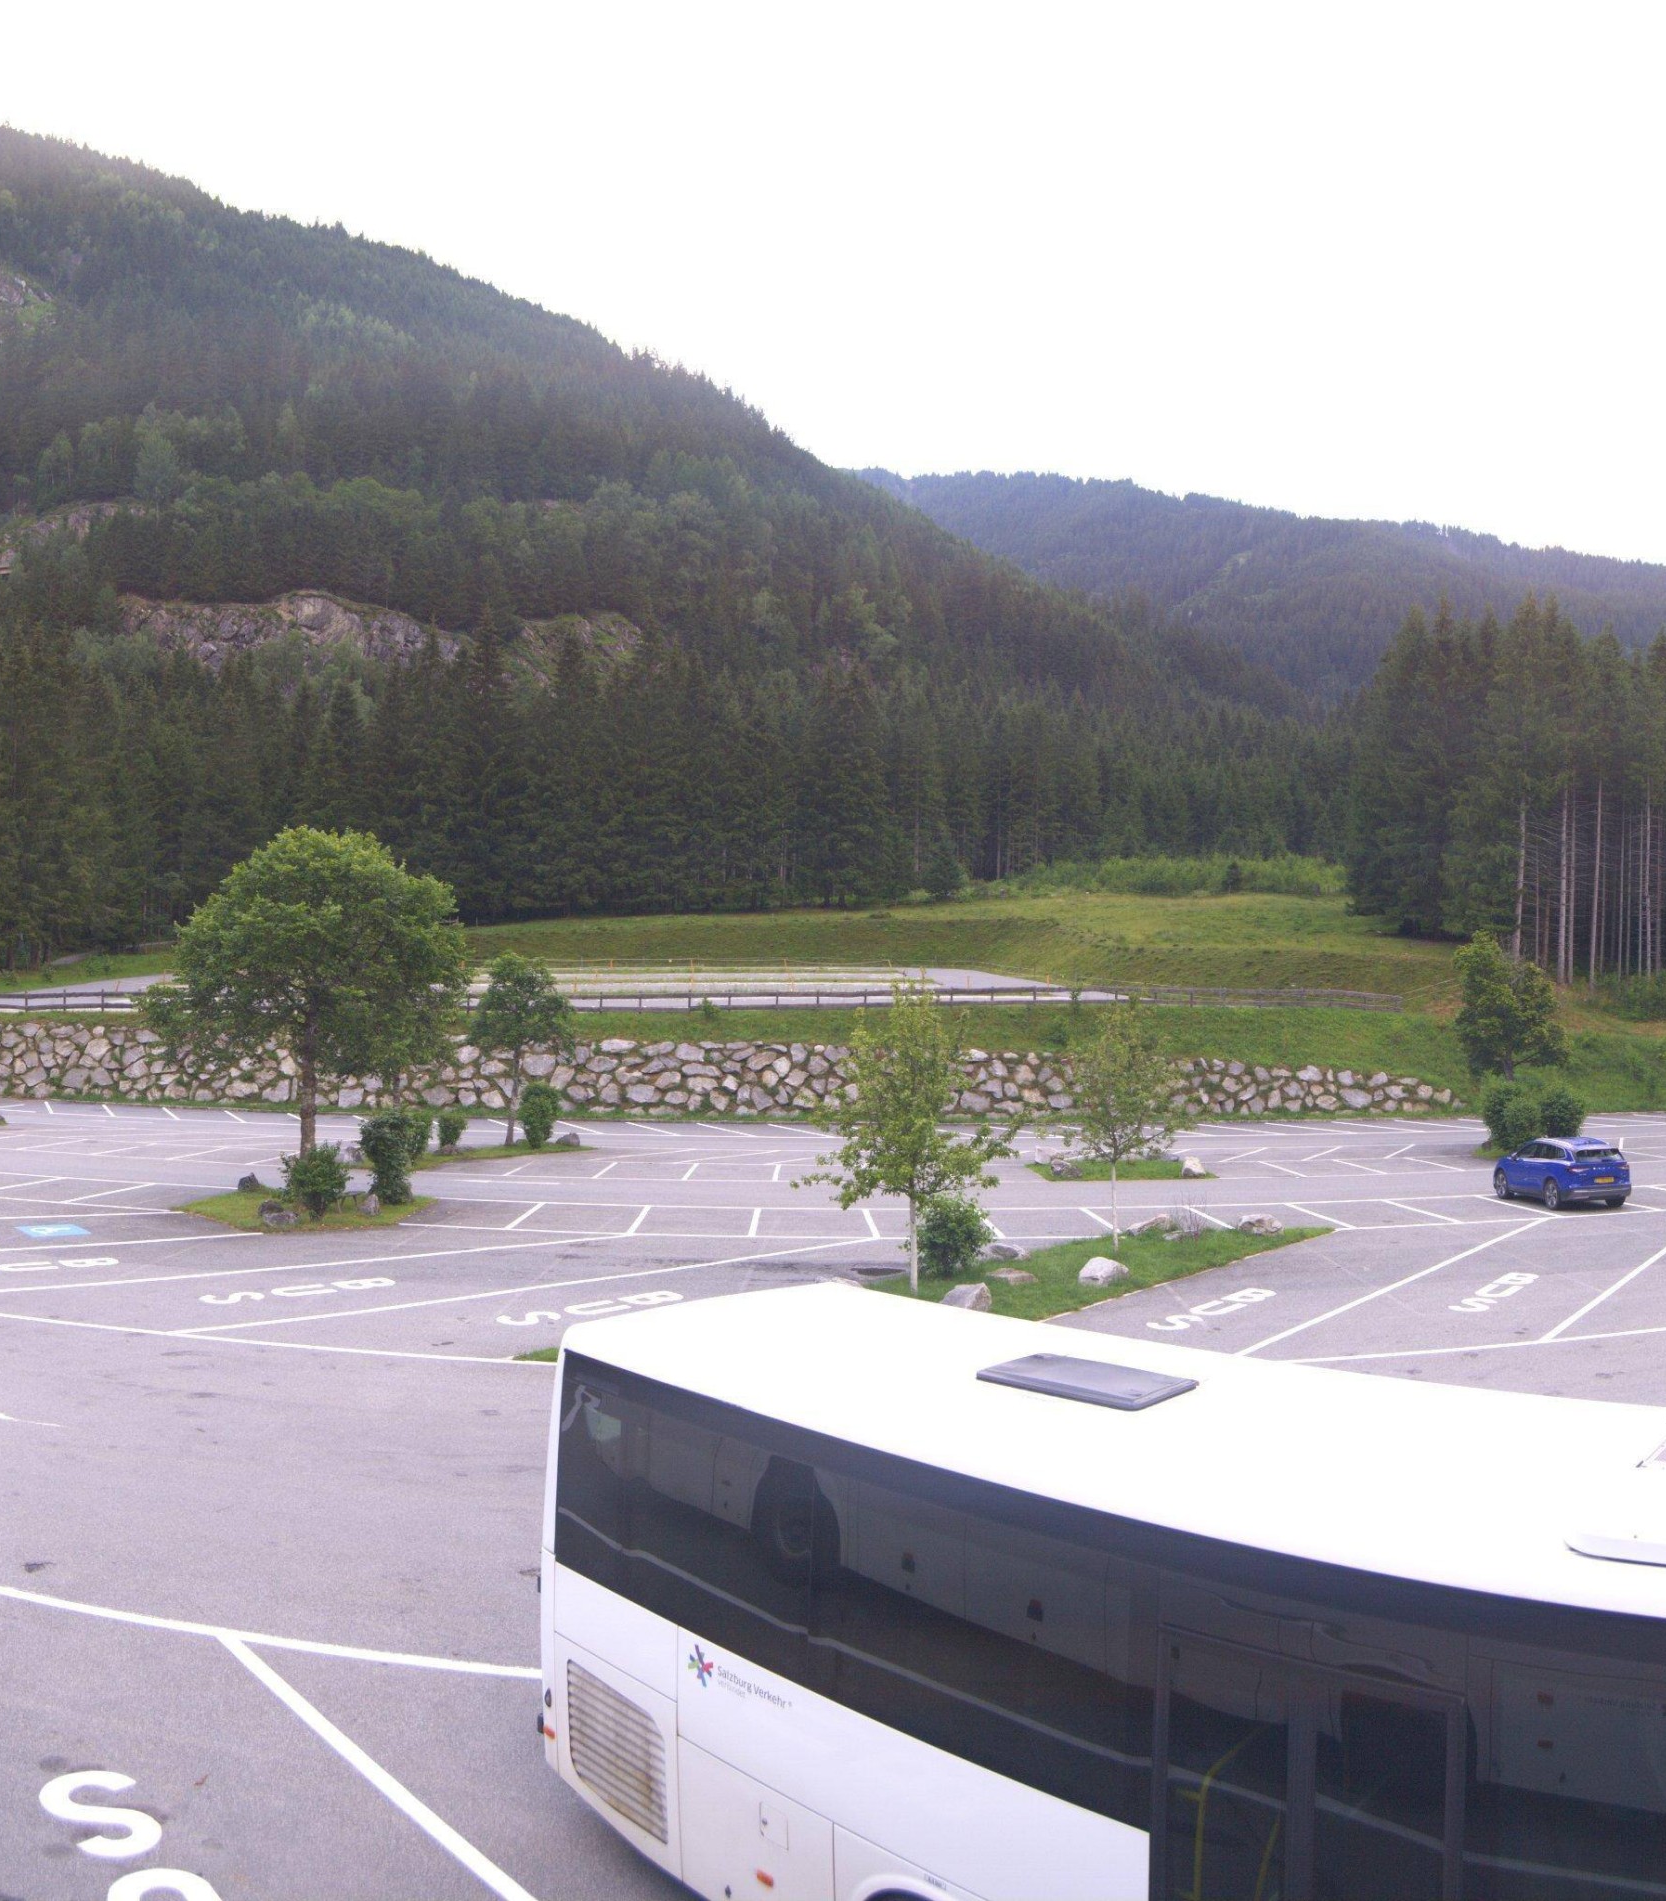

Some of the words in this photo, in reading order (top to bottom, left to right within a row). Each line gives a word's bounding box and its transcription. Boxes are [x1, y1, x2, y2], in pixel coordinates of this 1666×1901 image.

[198, 1277, 397, 1304] BUS
[496, 1290, 685, 1326] BUS
[1146, 1287, 1277, 1331] BUS
[1447, 1272, 1540, 1313] BUS
[717, 1665, 752, 1694] Salzburg
[753, 1683, 786, 1709] Verkehr
